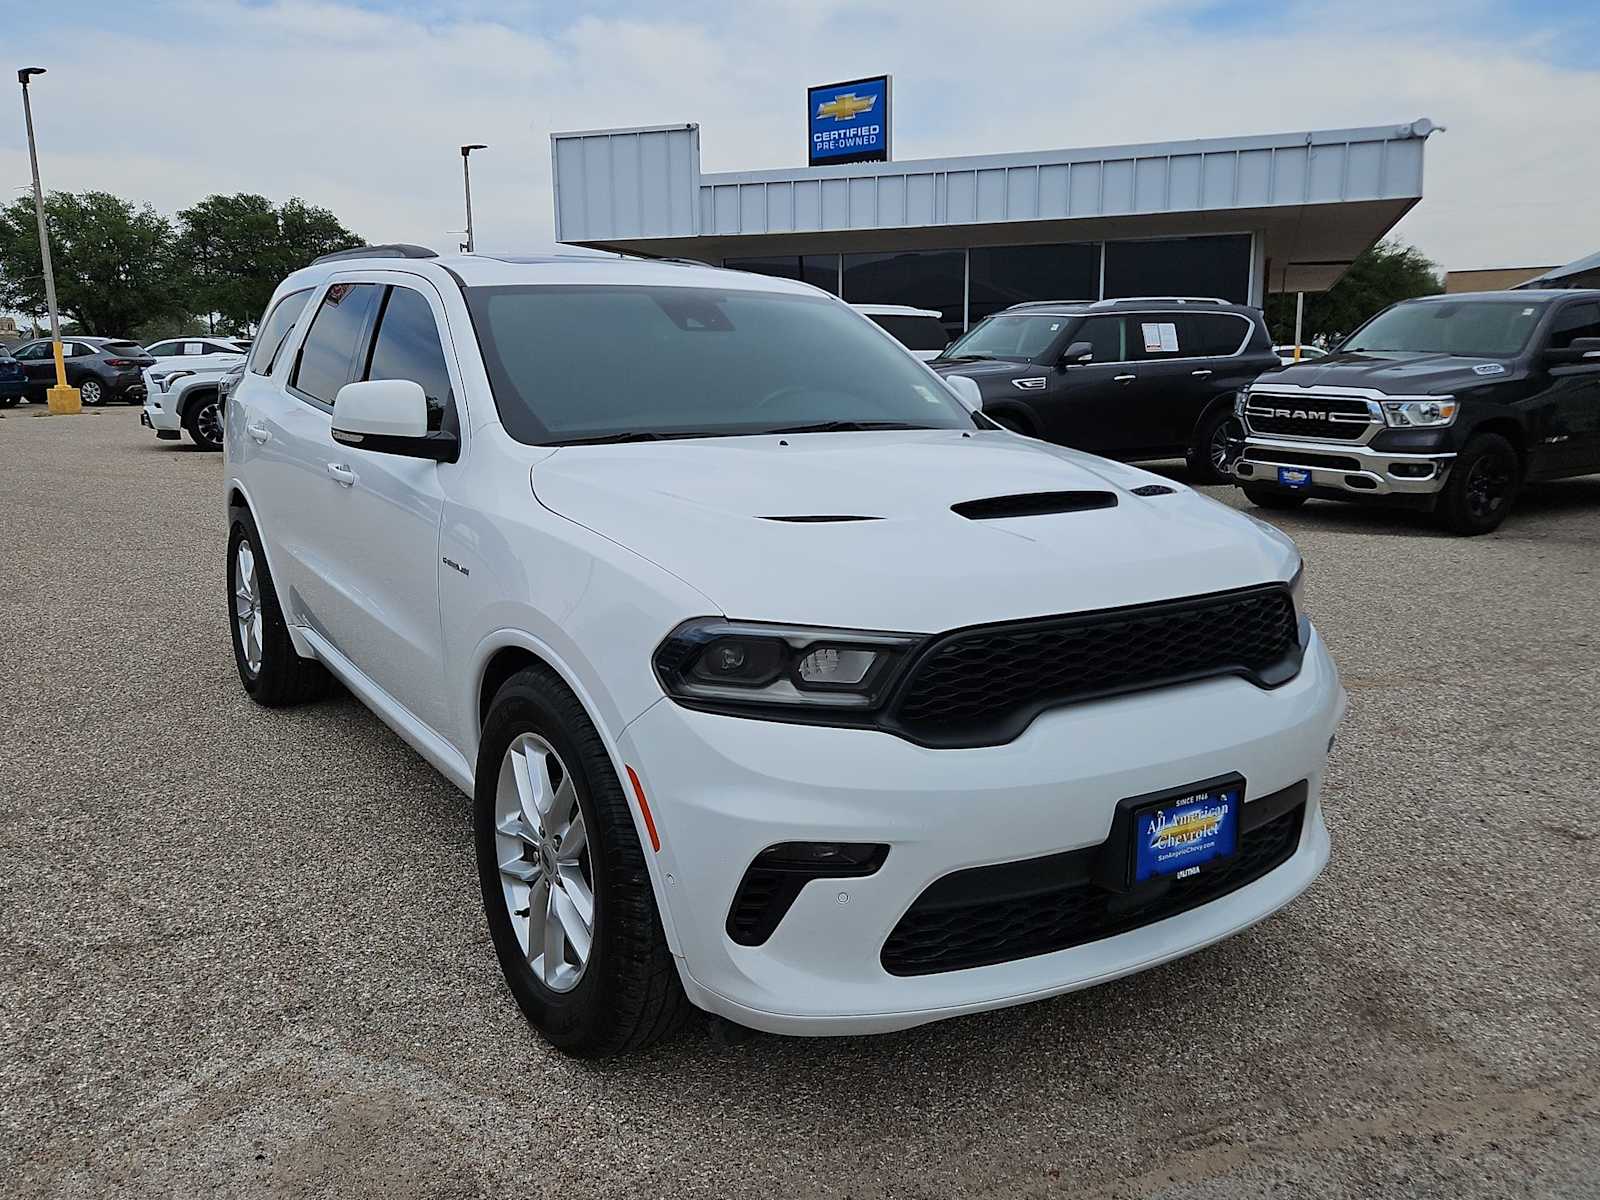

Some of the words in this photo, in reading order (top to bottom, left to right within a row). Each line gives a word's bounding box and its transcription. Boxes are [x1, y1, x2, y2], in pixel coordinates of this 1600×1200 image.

[813, 125, 880, 142] CERTIFIED
[816, 135, 877, 151] PRE-OWNED
[1276, 409, 1327, 420] RAM
[1176, 796, 1195, 807] SINCE
[1147, 814, 1166, 835] All
[1170, 804, 1229, 826] American
[1158, 823, 1219, 849] Chevrolet
